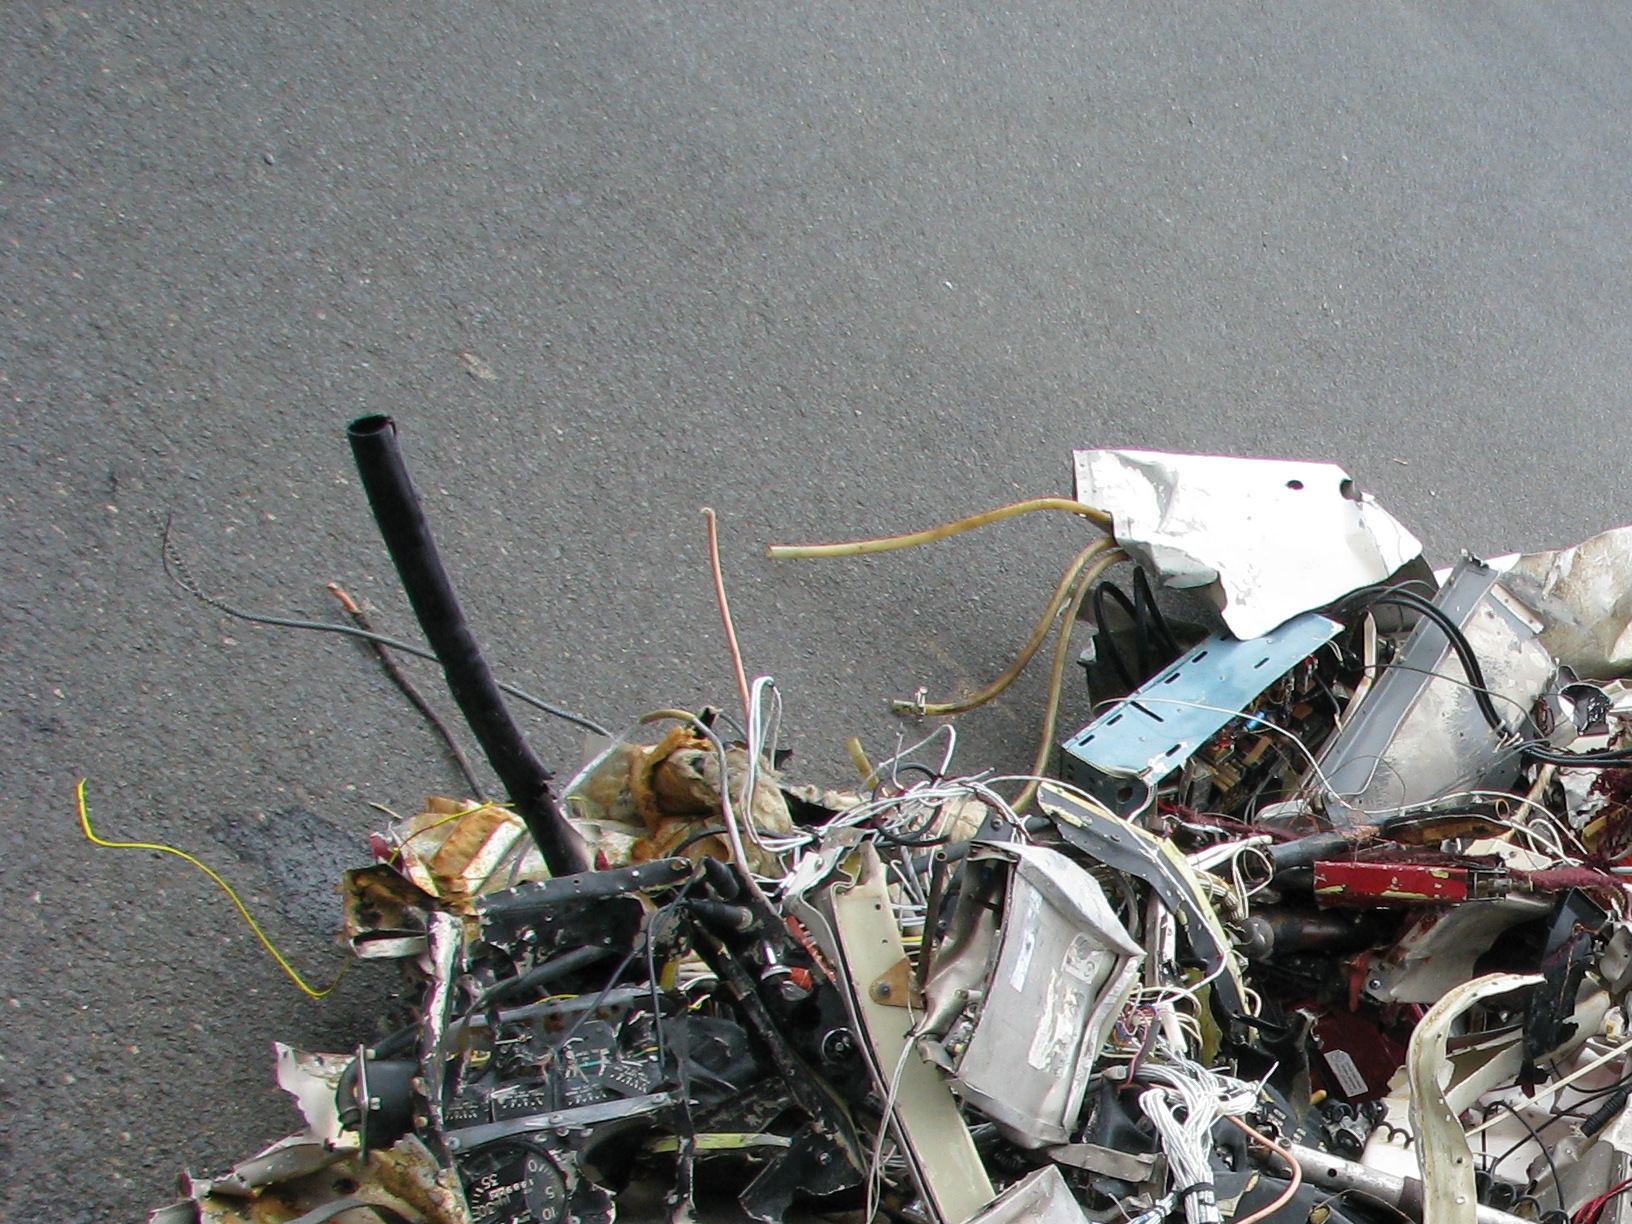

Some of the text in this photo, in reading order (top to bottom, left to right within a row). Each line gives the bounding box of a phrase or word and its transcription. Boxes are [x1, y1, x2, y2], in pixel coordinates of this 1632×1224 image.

[481, 1173, 499, 1189] 35
[545, 1186, 556, 1199] 5
[478, 1201, 496, 1217] 30
[542, 1207, 557, 1220] 10
